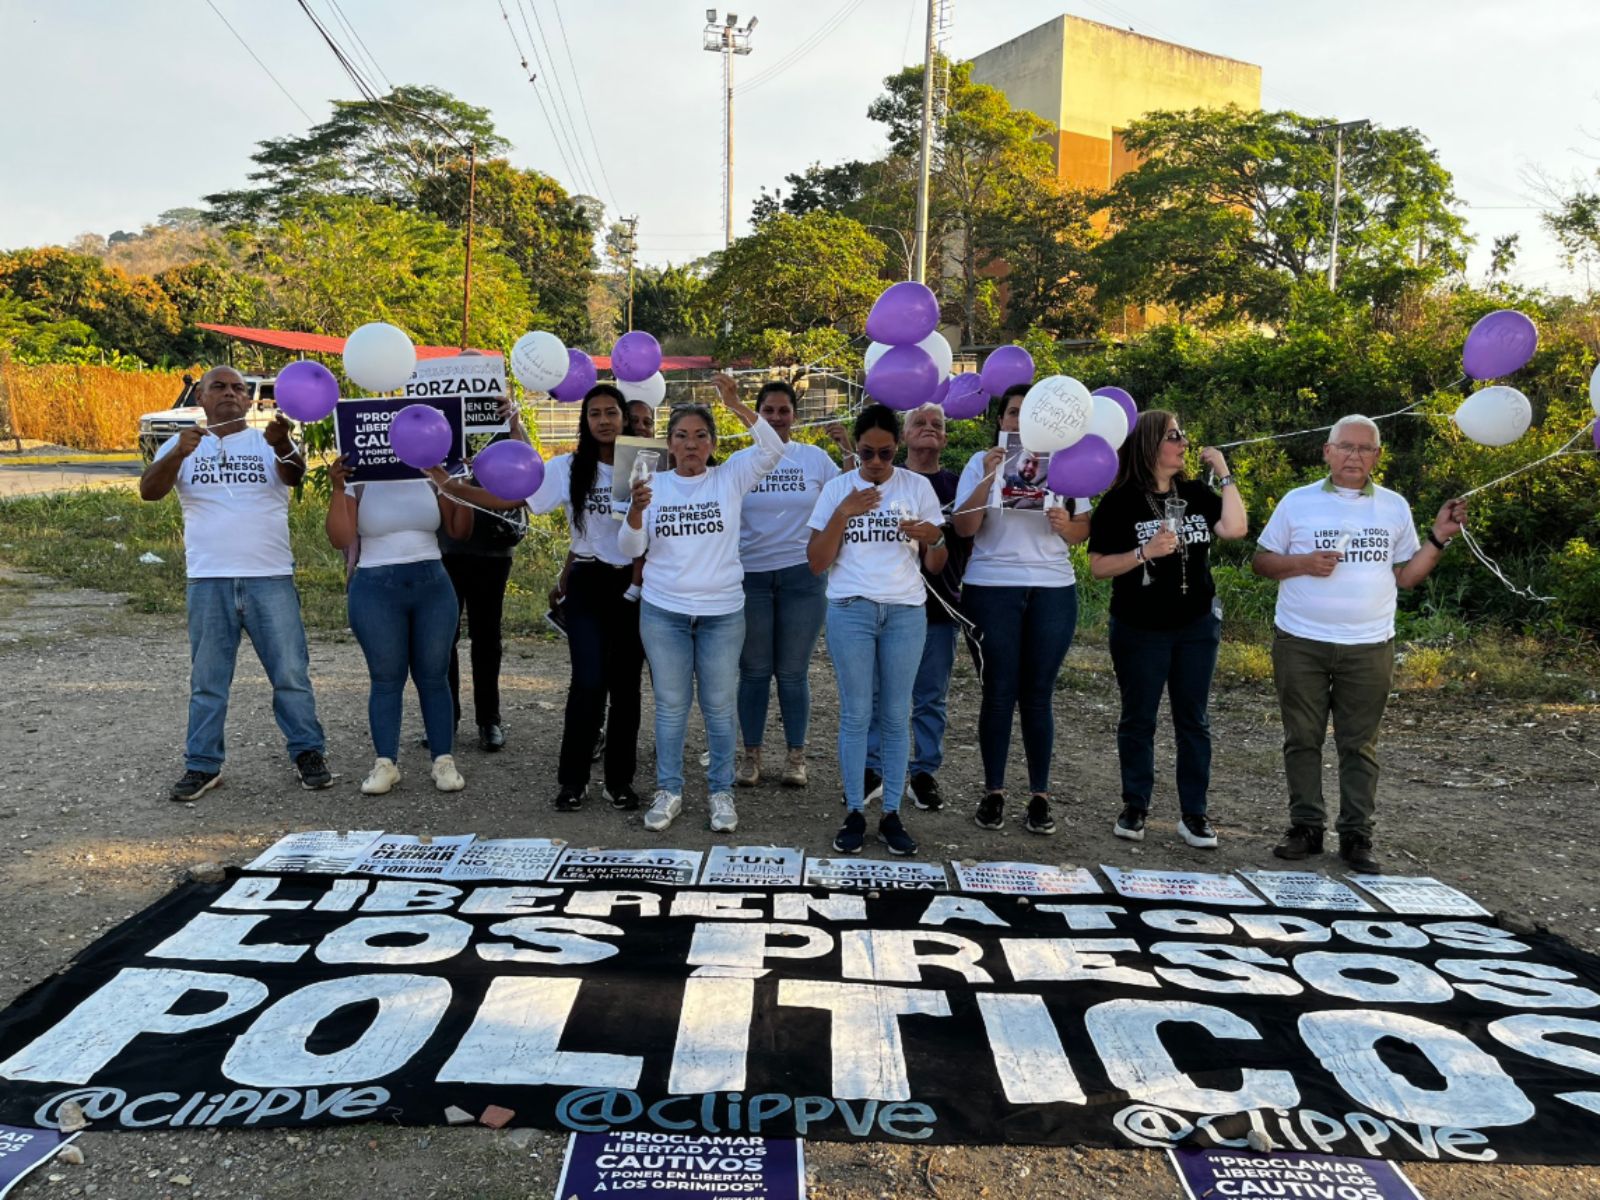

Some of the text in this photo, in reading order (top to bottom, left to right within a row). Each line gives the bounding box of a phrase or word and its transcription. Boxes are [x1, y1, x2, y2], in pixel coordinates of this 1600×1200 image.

[406, 378, 502, 396] FORZADA
[656, 508, 721, 524] LOS PRESOS
[1352, 538, 1389, 548] RESOS
[565, 855, 694, 868] FORZADA
[725, 855, 785, 865] TUN
[356, 864, 444, 874] DE TORTURA
[210, 876, 1532, 953] LIBEREN A TODOS
[146, 912, 1600, 1008] LOS PRESOS
[604, 1143, 768, 1156] LIBERTAD A LOS
[595, 1155, 763, 1172] CAUTIVOS
[611, 1171, 662, 1179] PONER
[667, 1172, 686, 1180] EN
[690, 1172, 763, 1181] LIBERTAD
[1212, 1169, 1377, 1186] LIBERTAD A LOS
[593, 1182, 608, 1192] A
[612, 1180, 647, 1190] LOS
[1216, 1180, 1385, 1200] CAUTIVOS
